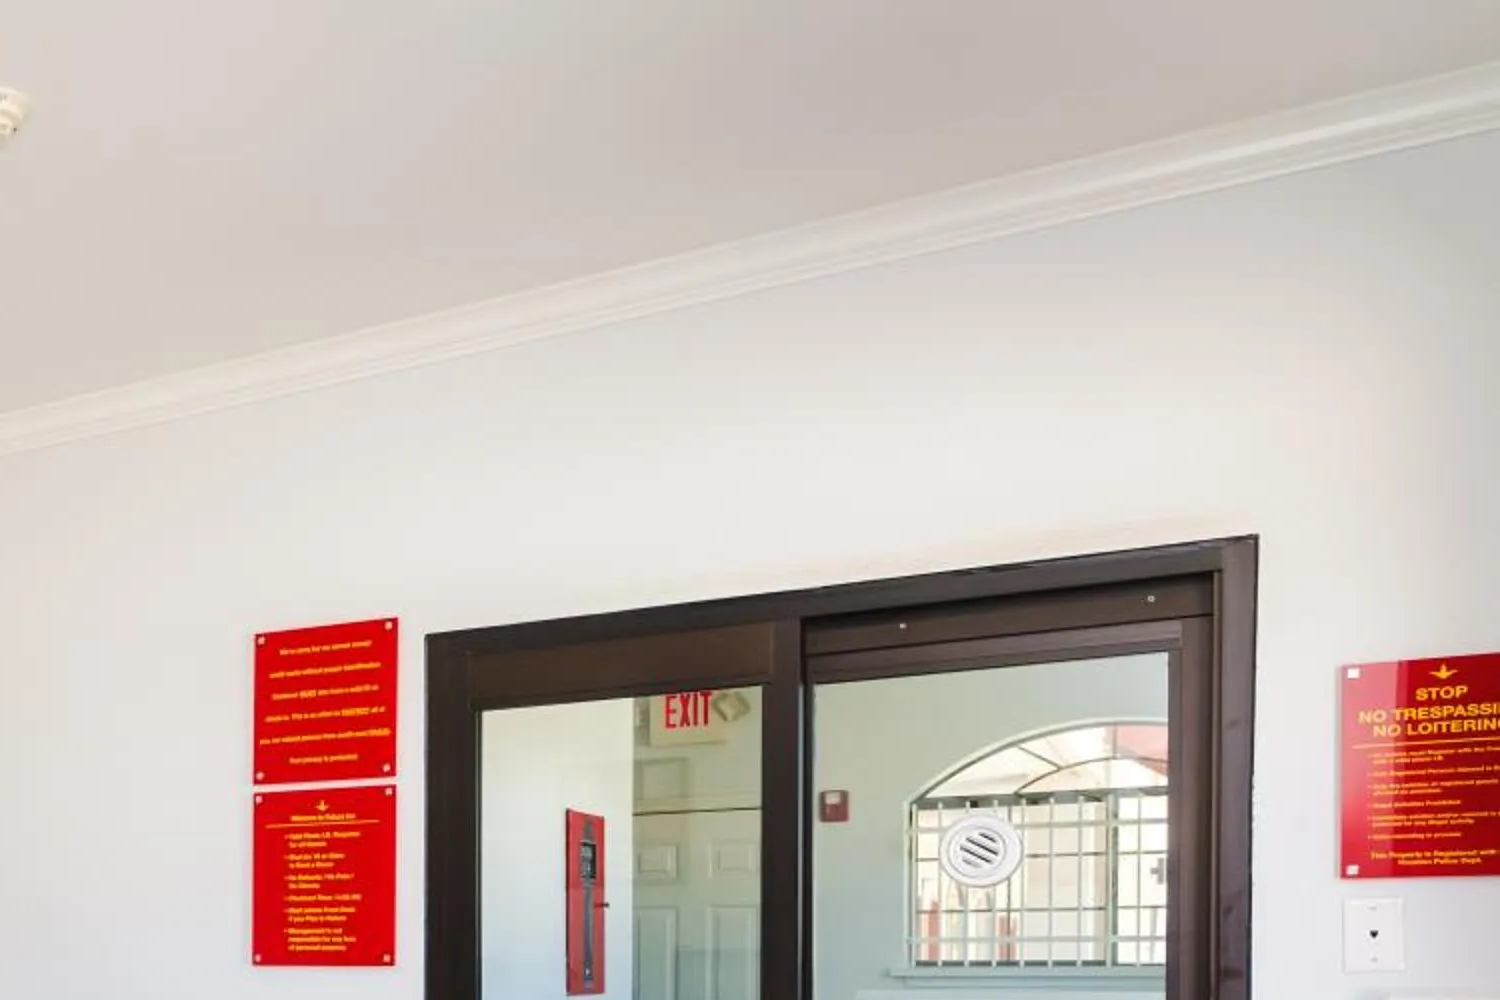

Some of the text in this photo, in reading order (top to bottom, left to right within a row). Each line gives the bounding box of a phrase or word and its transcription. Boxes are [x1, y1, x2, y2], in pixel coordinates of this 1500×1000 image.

[1415, 685, 1468, 701] STOP
[665, 691, 712, 728] EXIT
[1358, 703, 1500, 724] NO TRESPASSI
[1373, 717, 1500, 737] NO LOITERIN
